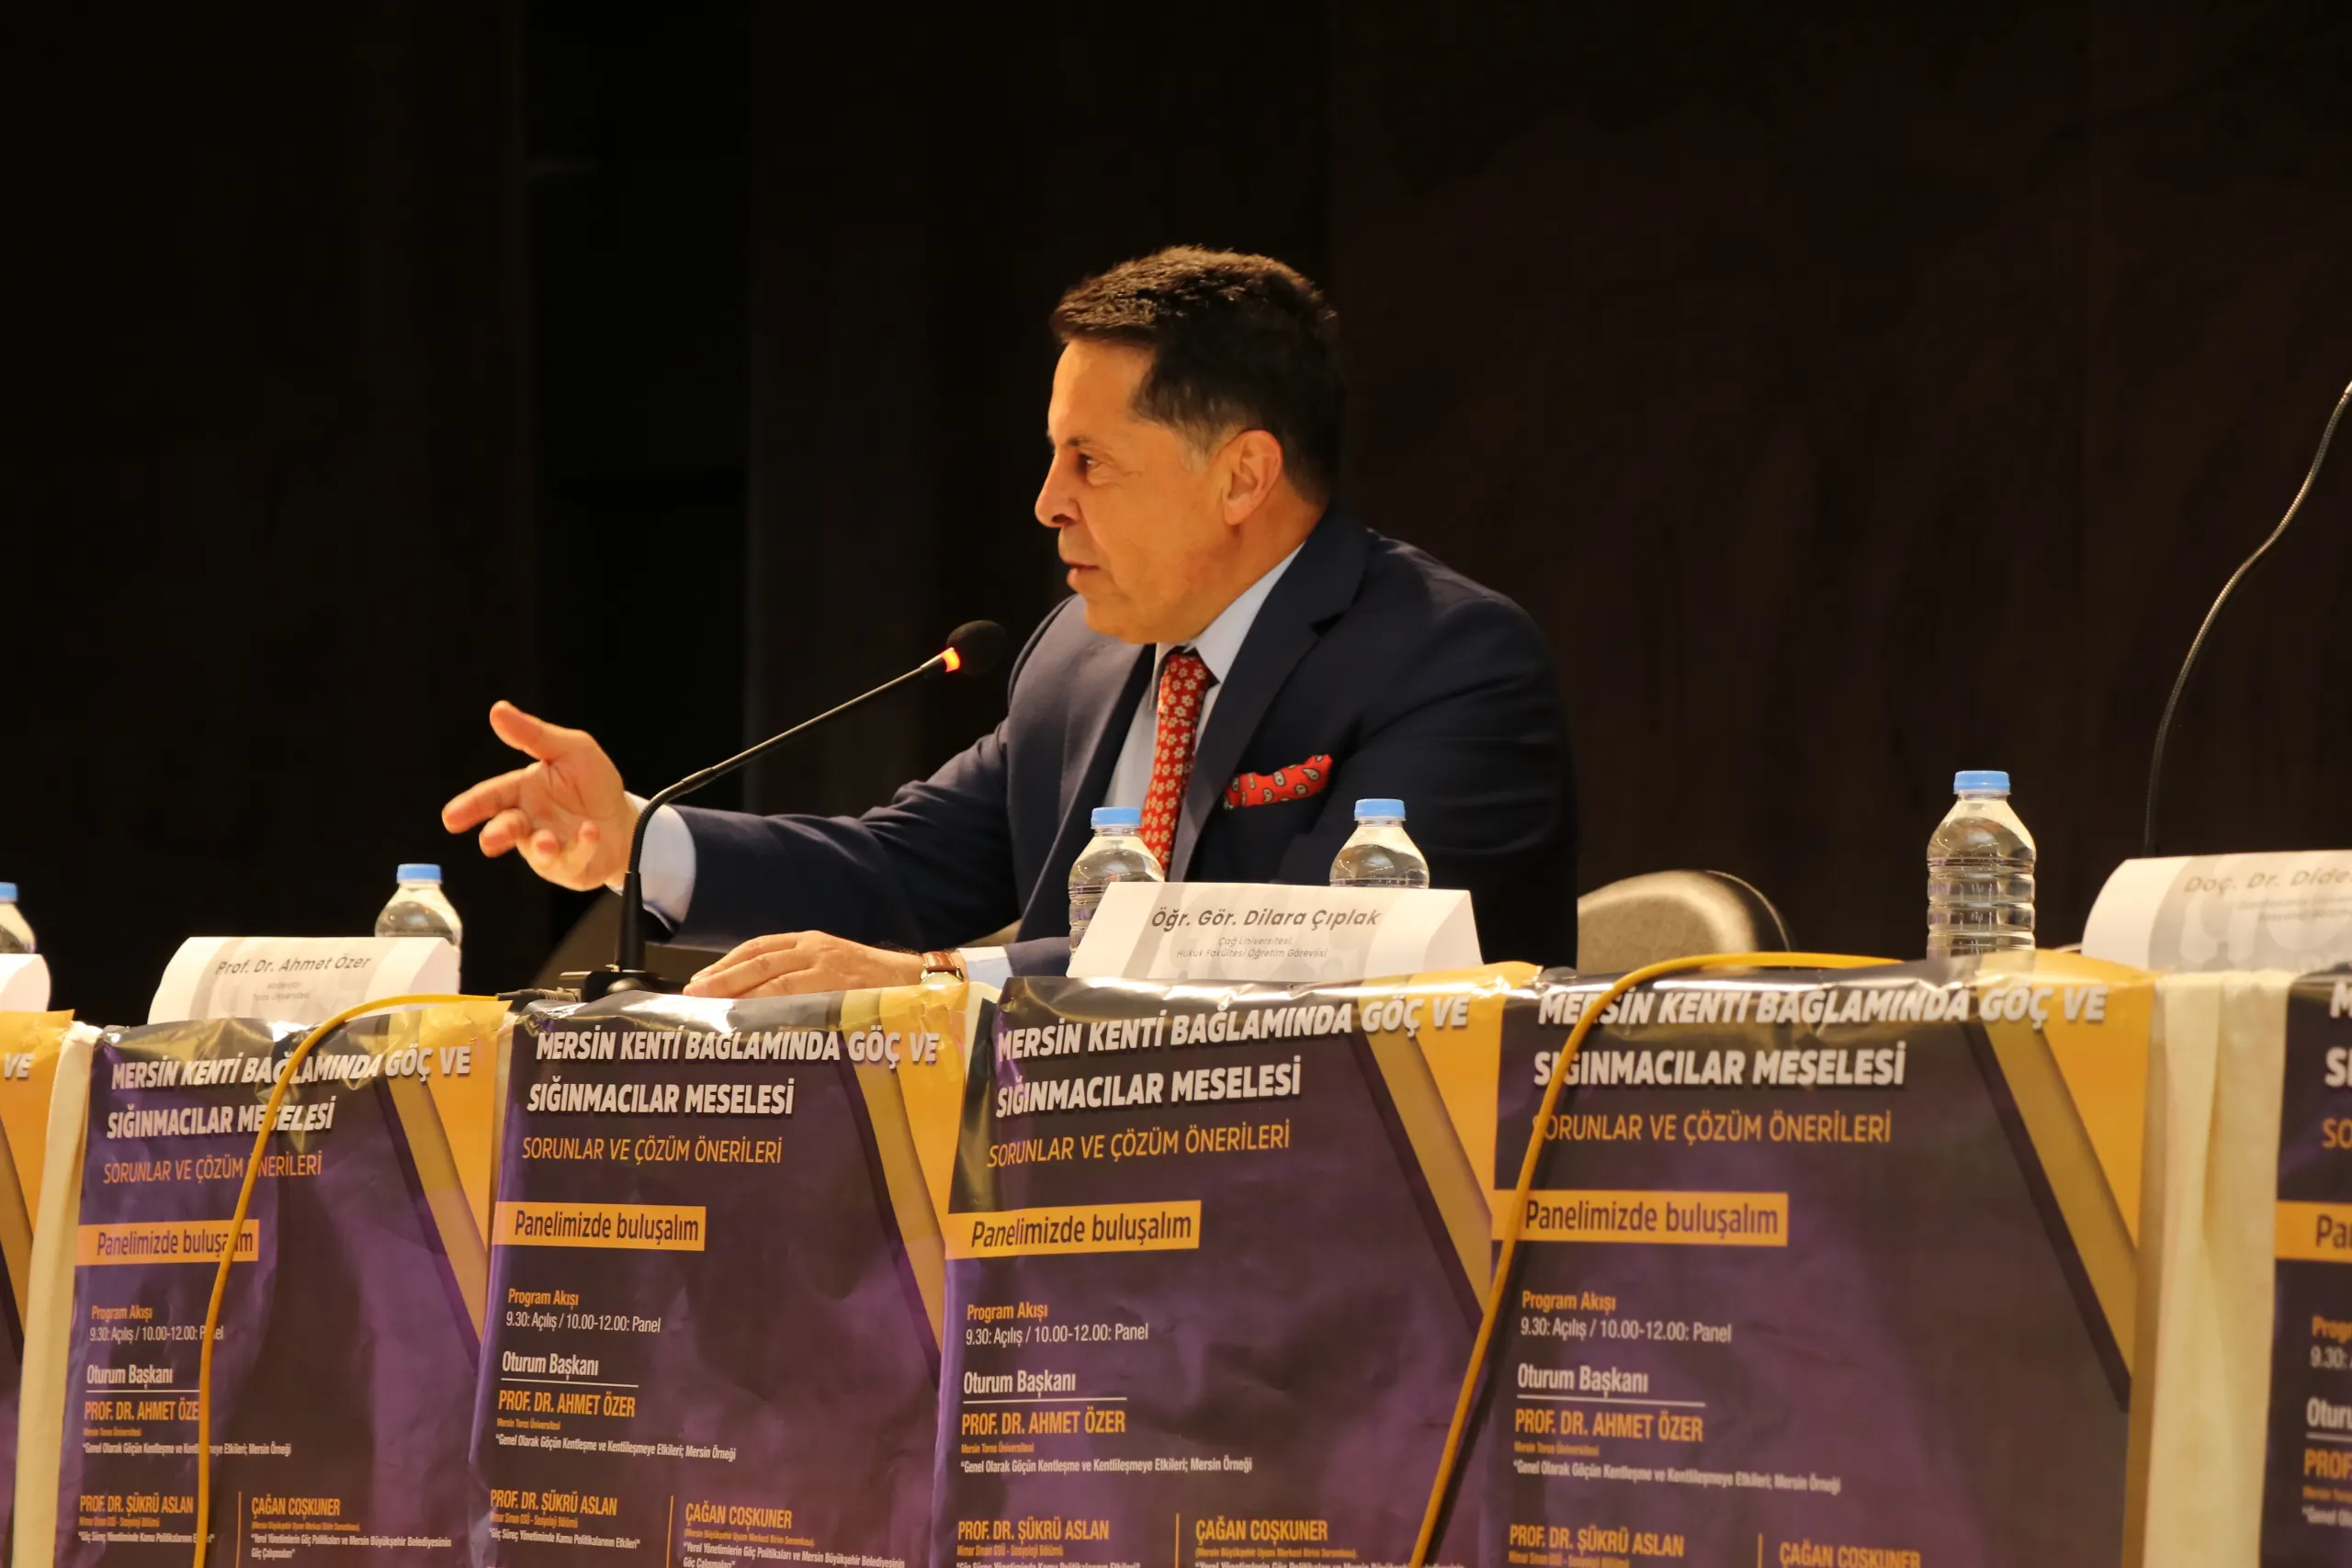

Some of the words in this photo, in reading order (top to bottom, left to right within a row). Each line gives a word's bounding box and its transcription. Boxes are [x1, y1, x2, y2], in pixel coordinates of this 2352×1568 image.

[2246, 872, 2280, 889] Dr.
[2290, 867, 2352, 886] Dide
[1151, 907, 1191, 932] Öğr.
[1198, 908, 1237, 926] Gör.
[1243, 908, 1306, 926] Dilara
[1312, 908, 1382, 931] Çıplak
[215, 959, 249, 975] Prof.
[254, 960, 274, 973] Dr.
[278, 957, 332, 972] Ahmet
[334, 953, 371, 969] Özer
[2063, 985, 2108, 1022] VE
[998, 1018, 1082, 1062] MERSİN
[1087, 1010, 1167, 1052] KENTİ
[1170, 1002, 1352, 1045] BAĞLAMINDA
[1361, 996, 1424, 1037] GÖÇ
[1432, 996, 1470, 1028] VE
[536, 1025, 616, 1060] MERSİN
[620, 1025, 684, 1060] KENTİ
[848, 1025, 900, 1068] GÖÇ
[909, 1032, 940, 1065] VE
[3, 1054, 35, 1078] VE
[111, 1055, 180, 1090] MERSİN
[180, 1052, 244, 1086] KENTİ
[384, 1043, 434, 1082] GÖÇ
[439, 1045, 471, 1075] VE
[1752, 1041, 1906, 1085] MESELESİ
[526, 1075, 679, 1112] SIĞINMACILAR
[684, 1078, 794, 1114] MESELESİ
[996, 1072, 1164, 1118] SIĞINMACILAR
[1170, 1055, 1301, 1102] MESELESİ
[107, 1104, 233, 1139] SIĞINMACILAR
[1650, 1114, 1677, 1140] VE
[1684, 1110, 1761, 1145] ÇÖZÜM
[1770, 1110, 1892, 1143] ÖNERİLERİ
[522, 1137, 605, 1160] SORUNLAR
[609, 1138, 630, 1160] VE
[635, 1135, 690, 1165] ÇÖZÜM
[695, 1135, 782, 1164] ÖNERİLERİ
[987, 1136, 1075, 1167] SORUNLAR
[1080, 1134, 1105, 1159] VE
[1111, 1126, 1179, 1162] ÇÖZÜM
[1185, 1119, 1290, 1153] ÖNERİLERİ
[103, 1159, 171, 1184] SORUNLAR
[175, 1159, 192, 1180] VE
[196, 1154, 243, 1183] ÇÖZÜM
[514, 1210, 611, 1238] Panelimizde
[616, 1213, 698, 1245] buluşalım
[971, 1213, 1085, 1248] Panelimizde
[1091, 1211, 1192, 1246] buluşalım
[1526, 1200, 1657, 1232] Panelimizde
[1666, 1202, 1778, 1239] buluşalım
[97, 1230, 178, 1256] Panelimizde
[92, 1305, 128, 1323] Program
[130, 1304, 153, 1323] Akışı
[508, 1289, 550, 1307] Program
[553, 1290, 579, 1310] Akışı
[967, 1304, 1013, 1324] Program
[1017, 1302, 1047, 1324] Akışı
[1521, 1291, 1577, 1313] Program
[1580, 1292, 1616, 1314] Akışı
[89, 1326, 110, 1341] 9.30:
[110, 1326, 133, 1345] Açılış
[141, 1325, 198, 1340] 10.00-12.00:
[506, 1311, 530, 1327] 9.30:
[531, 1313, 557, 1333] Açılış
[566, 1314, 630, 1332] 10.00-12.00:
[632, 1317, 661, 1333] Panel
[966, 1328, 991, 1345] 9.30:
[993, 1326, 1023, 1348] Açılış
[1034, 1325, 1112, 1343] 10.00-12.00:
[1114, 1323, 1148, 1341] Panel
[1521, 1317, 1551, 1337] 9.30:
[1553, 1319, 1588, 1342] Açılış
[1600, 1320, 1690, 1341] 10.00-12.00:
[1692, 1323, 1732, 1343] Panel
[86, 1364, 125, 1384] Oturum
[129, 1364, 173, 1389] Başkanı
[503, 1350, 547, 1373] Oturum
[549, 1353, 598, 1381] Başkanı
[1518, 1363, 1574, 1390] Oturum
[1578, 1366, 1648, 1397] Başkanı
[964, 1371, 1012, 1393] Oturum
[1017, 1370, 1076, 1398] Başkanı
[85, 1401, 114, 1421] PROF.
[116, 1401, 133, 1421] DR.
[136, 1401, 175, 1421] AHMET
[178, 1397, 199, 1421] ÖZE
[498, 1390, 531, 1411] PROF.
[534, 1392, 554, 1413] DR.
[557, 1393, 601, 1416] AHMET
[603, 1391, 636, 1417] ÖZER
[961, 1414, 998, 1435] PROF.
[1001, 1413, 1025, 1434] DR.
[1028, 1411, 1080, 1434] AHMET
[1084, 1406, 1125, 1434] ÖZER
[1515, 1409, 1555, 1433] PROF.
[1560, 1411, 1589, 1437] DR.
[1592, 1413, 1654, 1438] AHMET
[1657, 1410, 1703, 1442] ÖZER
[518, 1435, 539, 1448] Olarak
[540, 1437, 561, 1450] Göçün
[562, 1437, 597, 1453] Kentleşme
[598, 1442, 606, 1451] ve
[685, 1446, 710, 1459] Mersin
[712, 1445, 737, 1461] Örneği
[986, 1461, 1010, 1473] Olarak
[1012, 1460, 1035, 1475] Göçün
[1038, 1459, 1080, 1475] Kentleşme
[1081, 1462, 1091, 1472] ve
[1190, 1458, 1221, 1472] Mersin
[1223, 1455, 1252, 1474] Örneği
[80, 1495, 106, 1513] PROF.
[107, 1495, 124, 1513] DR.
[126, 1492, 160, 1517] ŞÜKRÜ
[161, 1496, 194, 1514] ASLAN
[251, 1493, 286, 1519] ÇAĞAN
[288, 1498, 341, 1519] COŞKUNER
[491, 1489, 518, 1508] PROF.
[521, 1492, 538, 1510] DR.
[541, 1489, 578, 1517] ŞÜKRÜ
[581, 1497, 617, 1516] ASLAN
[684, 1500, 726, 1527] ÇAĞAN
[729, 1506, 793, 1530] COŞKUNER
[957, 1521, 989, 1540] PROF.
[993, 1521, 1014, 1540] DR.
[1018, 1516, 1061, 1545] ŞÜKRÜ
[1065, 1520, 1109, 1540] ASLAN
[1195, 1516, 1246, 1545] ÇAĞAN
[1250, 1519, 1328, 1546] COŞKUNER
[1510, 1524, 1545, 1548] PROF.
[1548, 1527, 1573, 1550] DR.
[1577, 1525, 1628, 1557] ŞÜKRÜ
[1632, 1533, 1684, 1557] ASLAN
